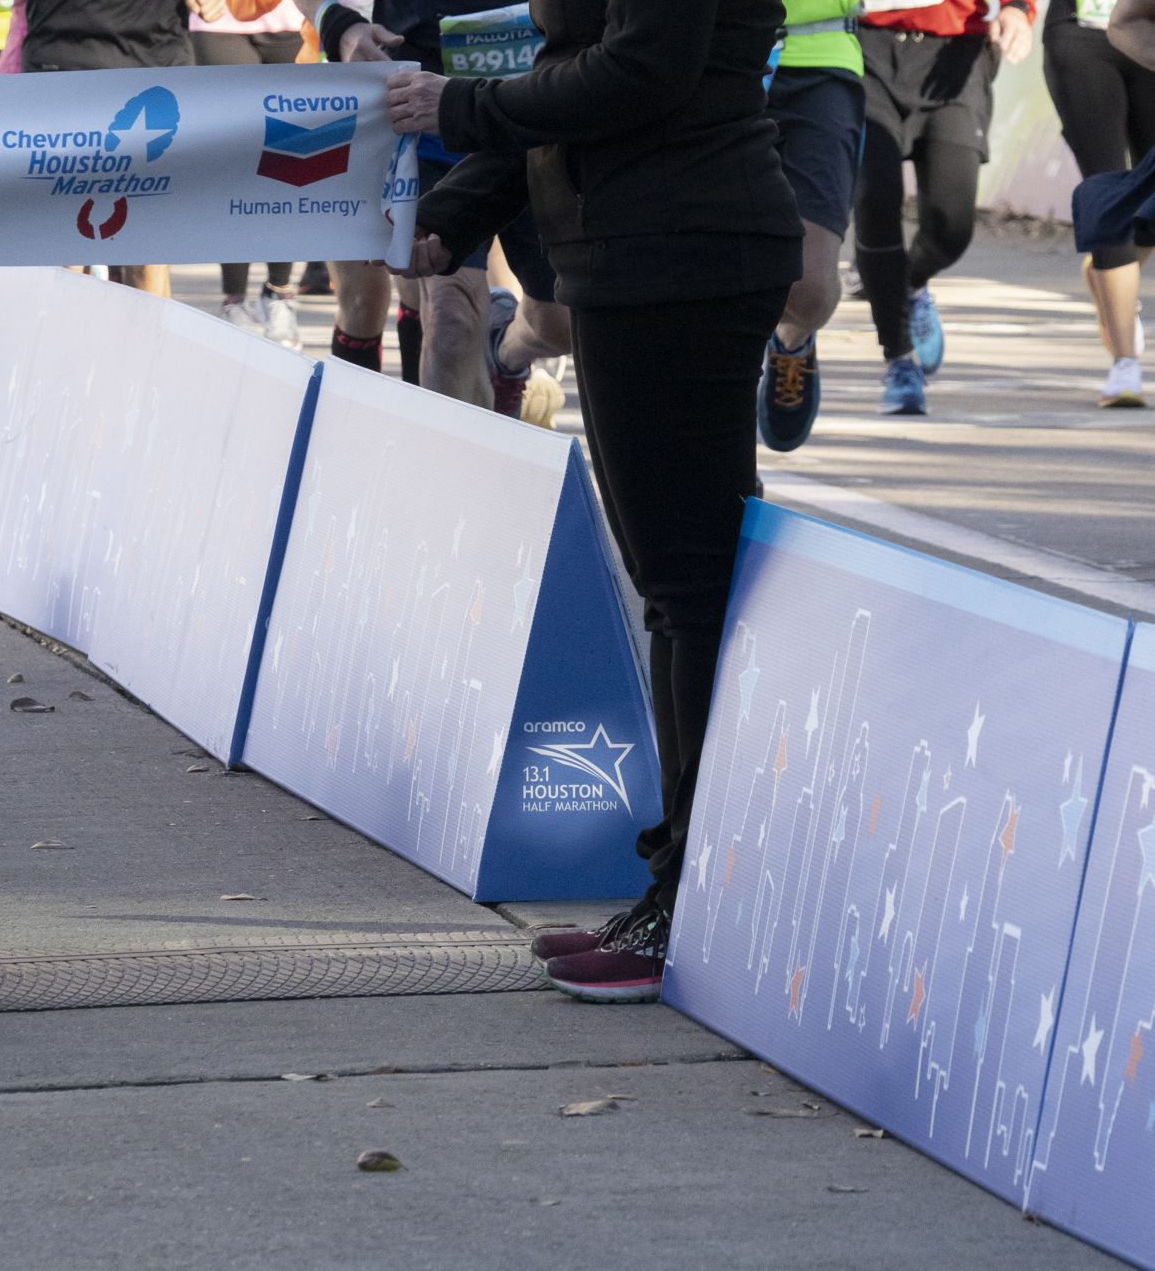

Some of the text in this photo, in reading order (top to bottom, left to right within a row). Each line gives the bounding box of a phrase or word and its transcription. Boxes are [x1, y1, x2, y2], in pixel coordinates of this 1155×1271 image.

[263, 95, 359, 113] Chevron
[1, 129, 102, 149] Chevron
[27, 149, 132, 175] Houston
[50, 172, 171, 196] Marathon
[229, 198, 293, 215] Human
[523, 721, 586, 733] aramco
[522, 766, 549, 782] 13.1
[522, 784, 603, 799] HOUSTON
[522, 800, 617, 812] HALF MARATHON
